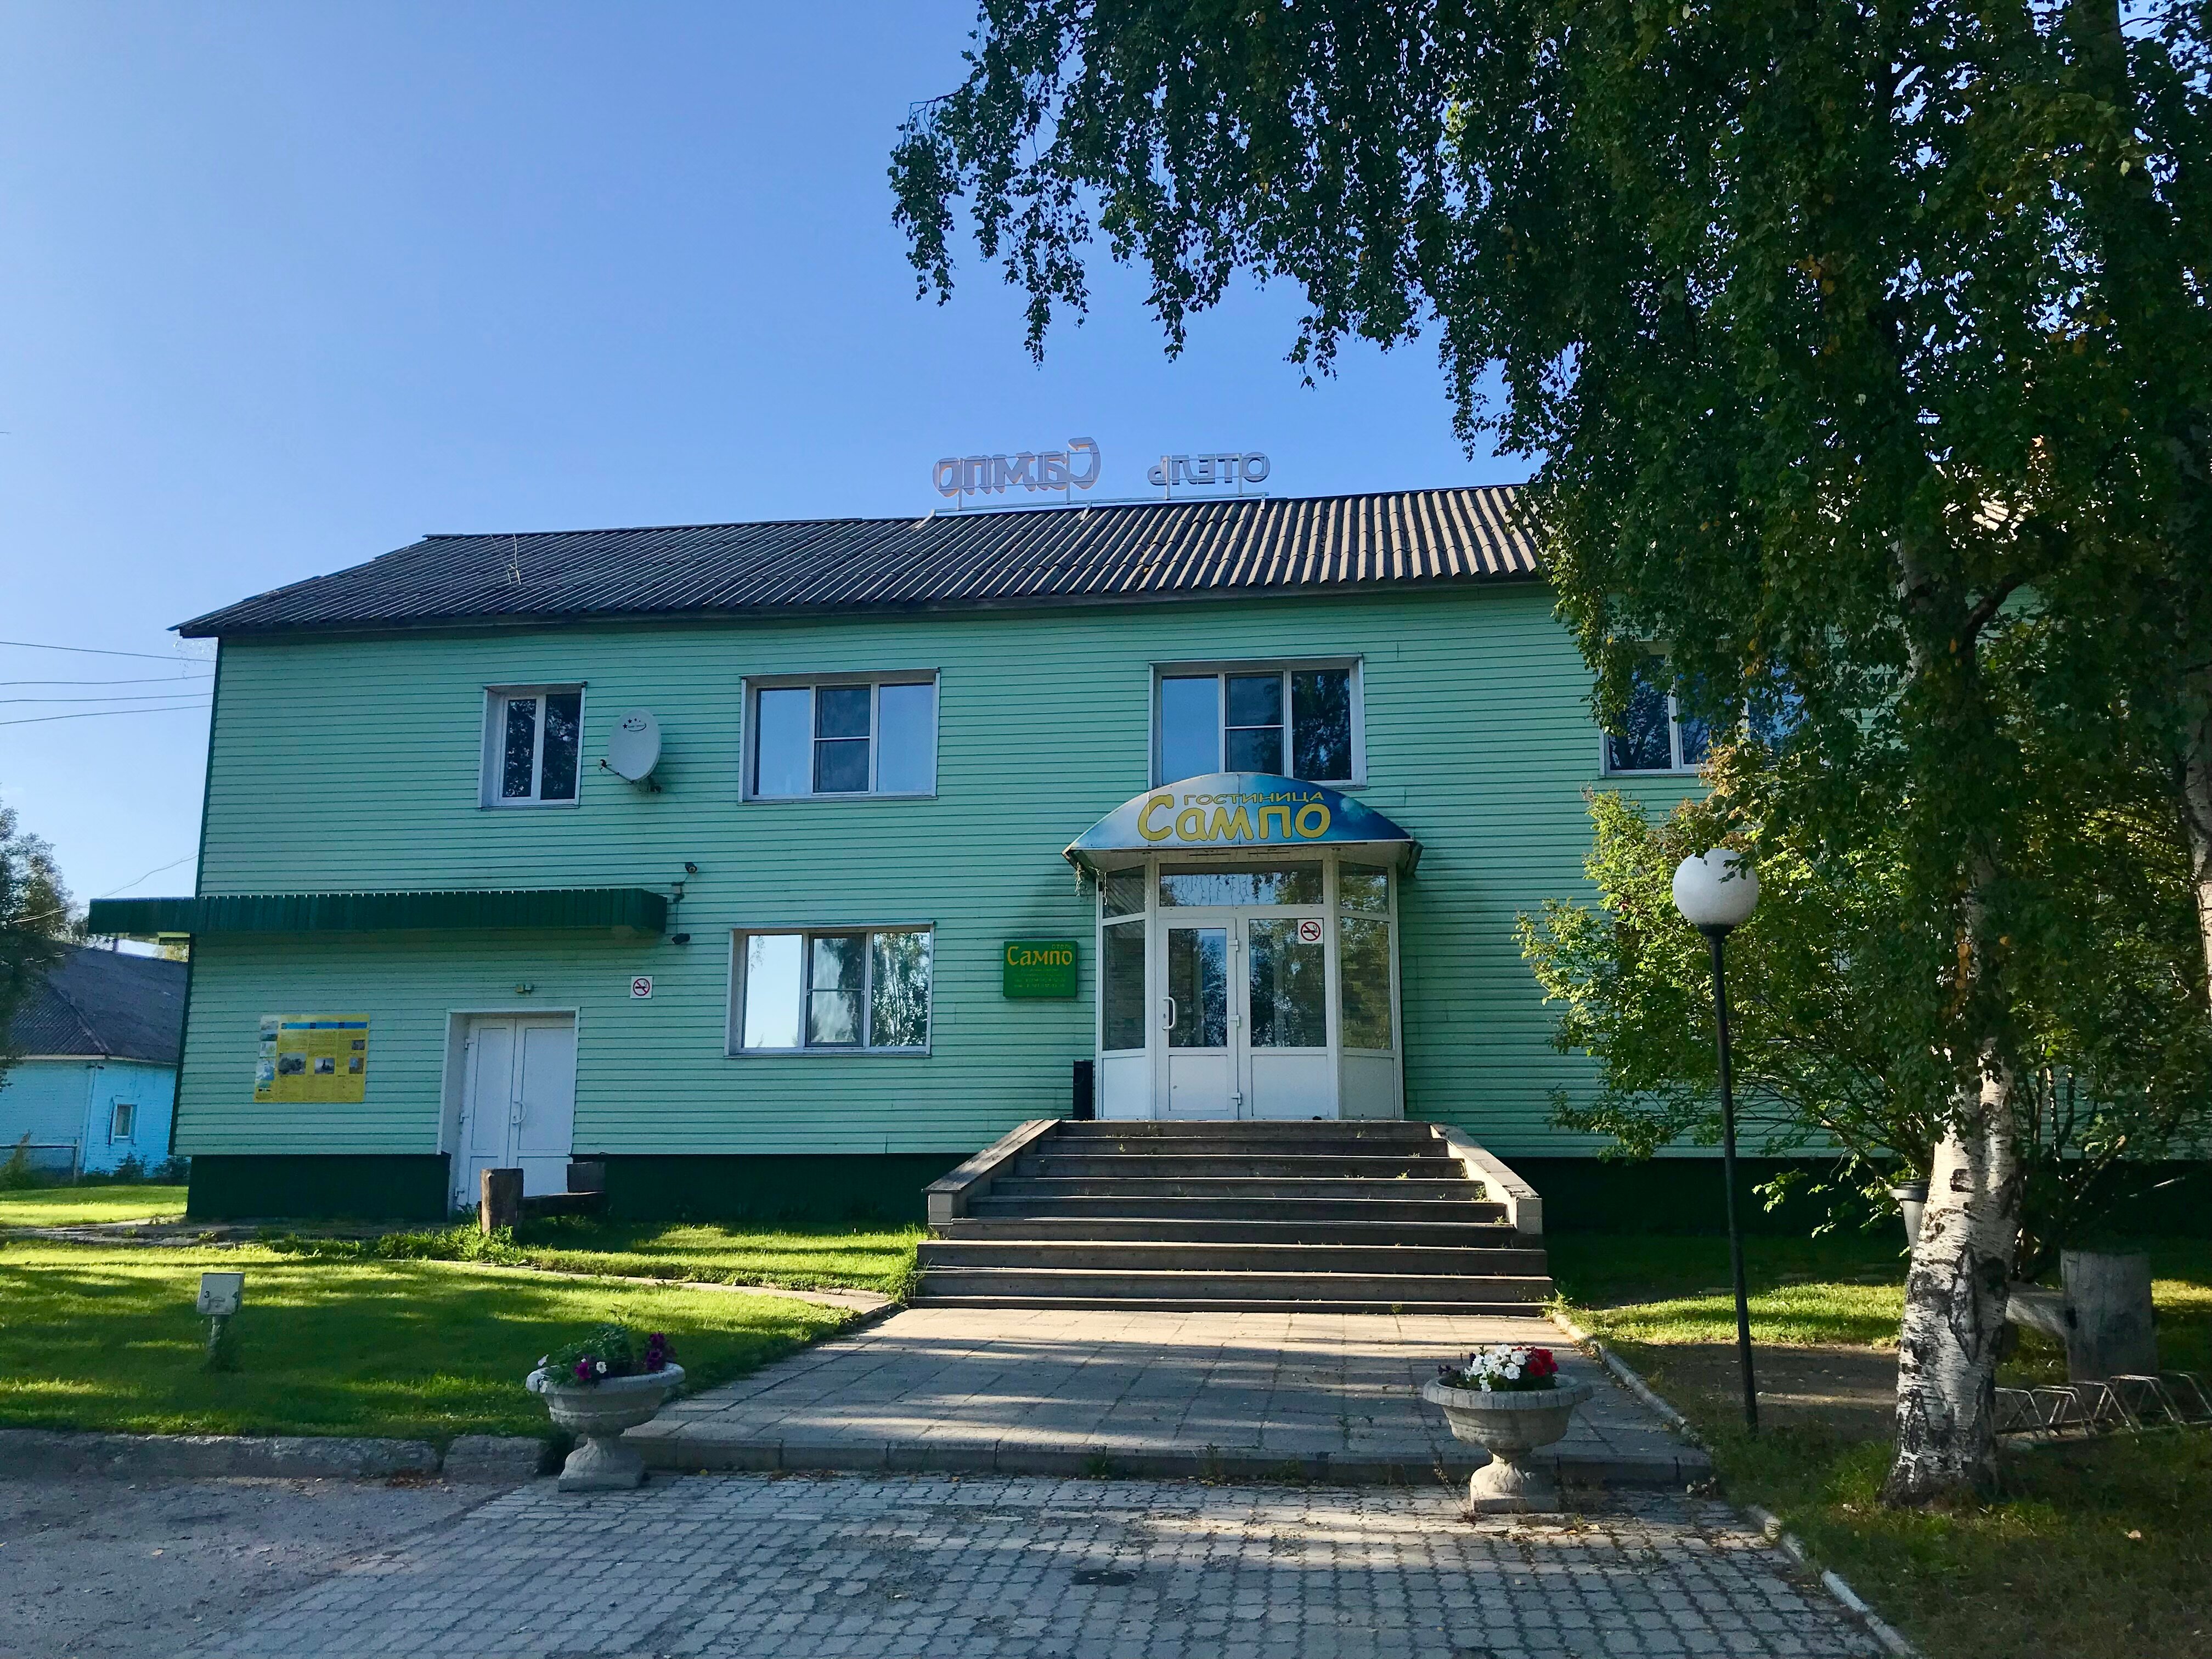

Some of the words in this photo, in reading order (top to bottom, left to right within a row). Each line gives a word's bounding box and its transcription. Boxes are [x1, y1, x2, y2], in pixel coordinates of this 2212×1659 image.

[1183, 791, 1324, 805] ГОСТИНИЦА
[1138, 794, 1331, 842] Сампо
[1007, 946, 1073, 966] Сампо
